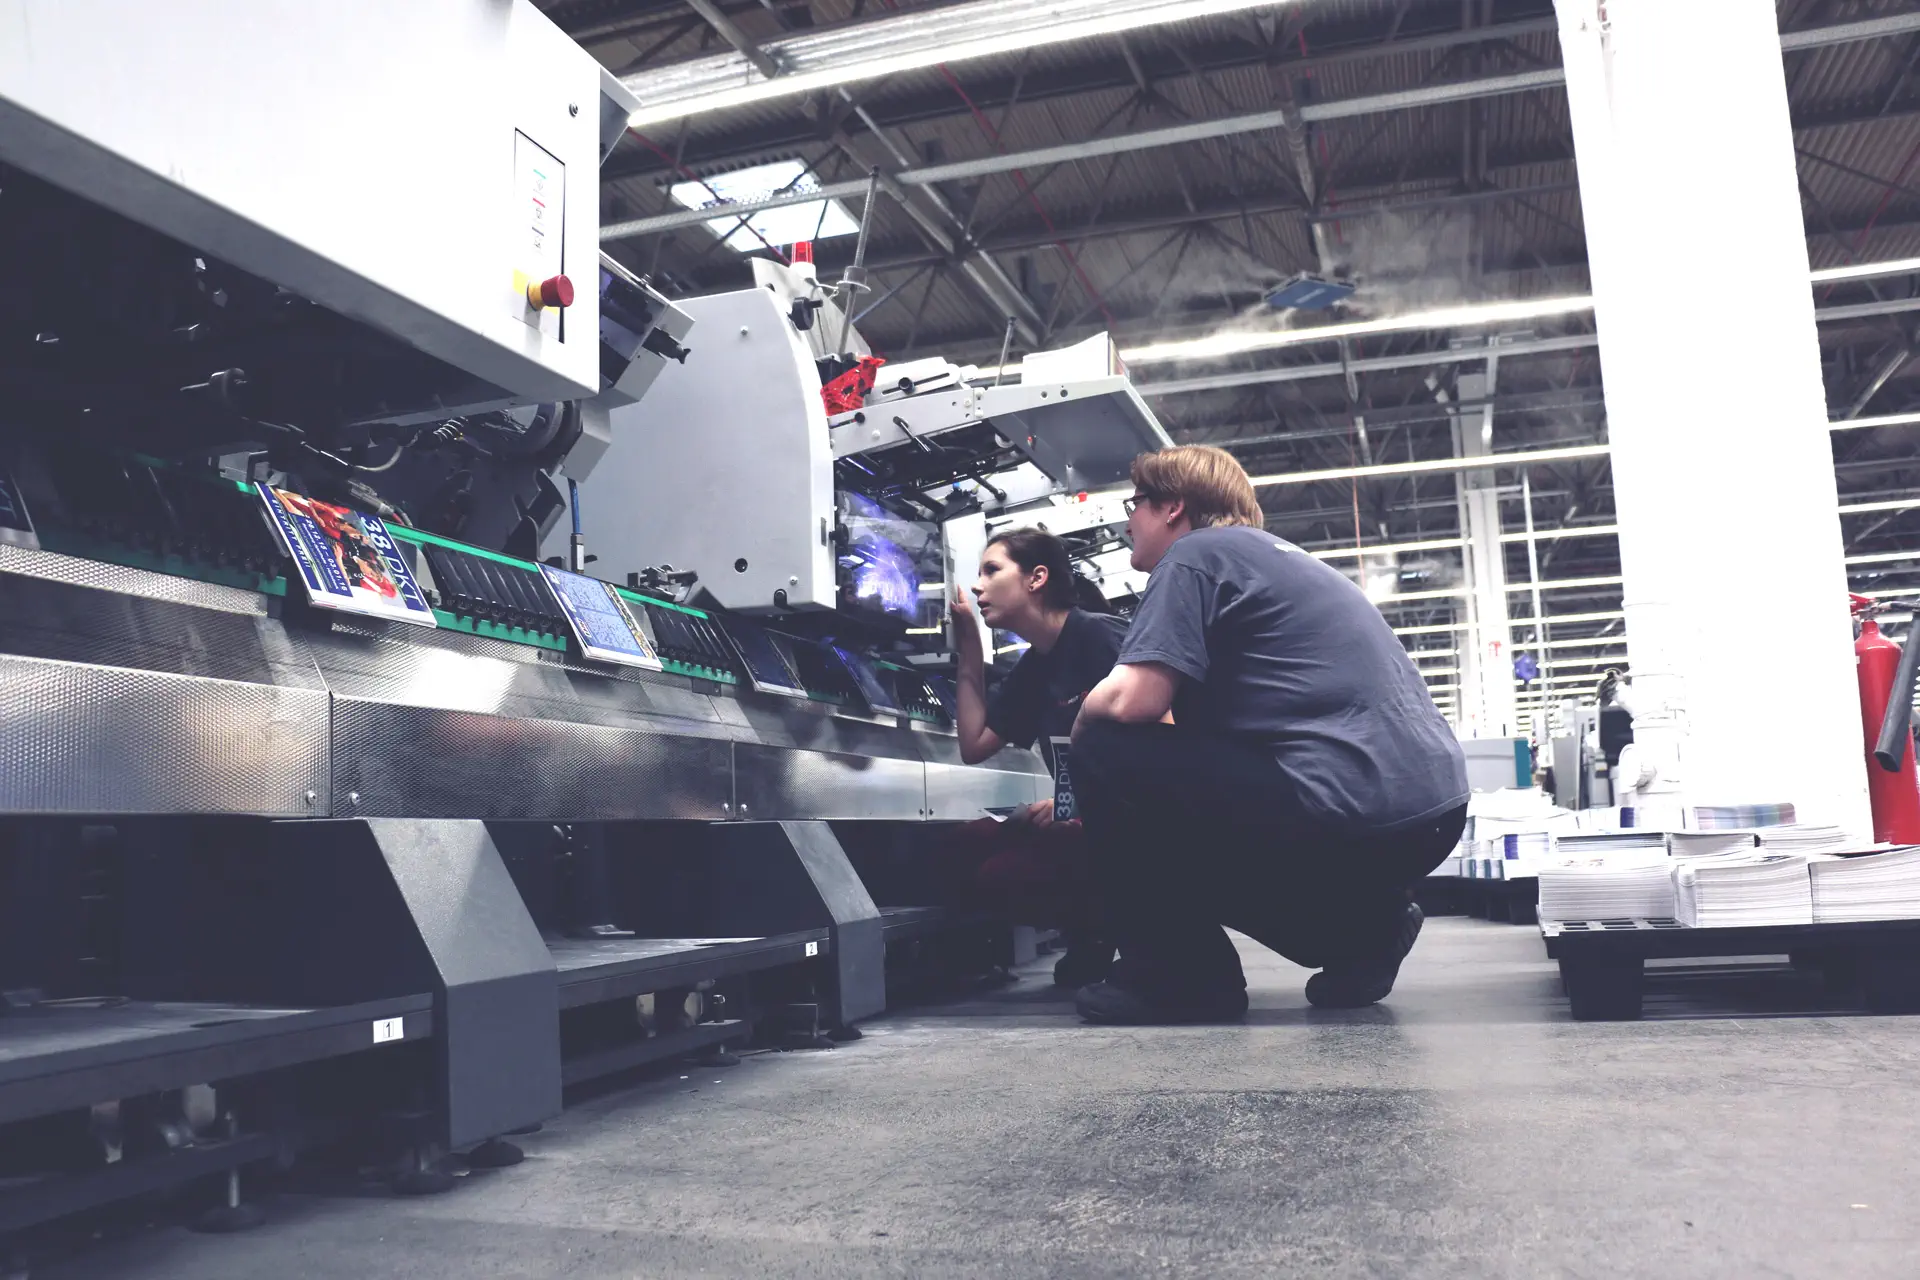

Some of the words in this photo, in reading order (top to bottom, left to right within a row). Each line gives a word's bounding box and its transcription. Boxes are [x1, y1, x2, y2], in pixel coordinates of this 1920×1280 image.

[272, 499, 298, 541] EINTRITT
[361, 516, 424, 606] 38.DKT
[385, 1021, 391, 1038] 1
